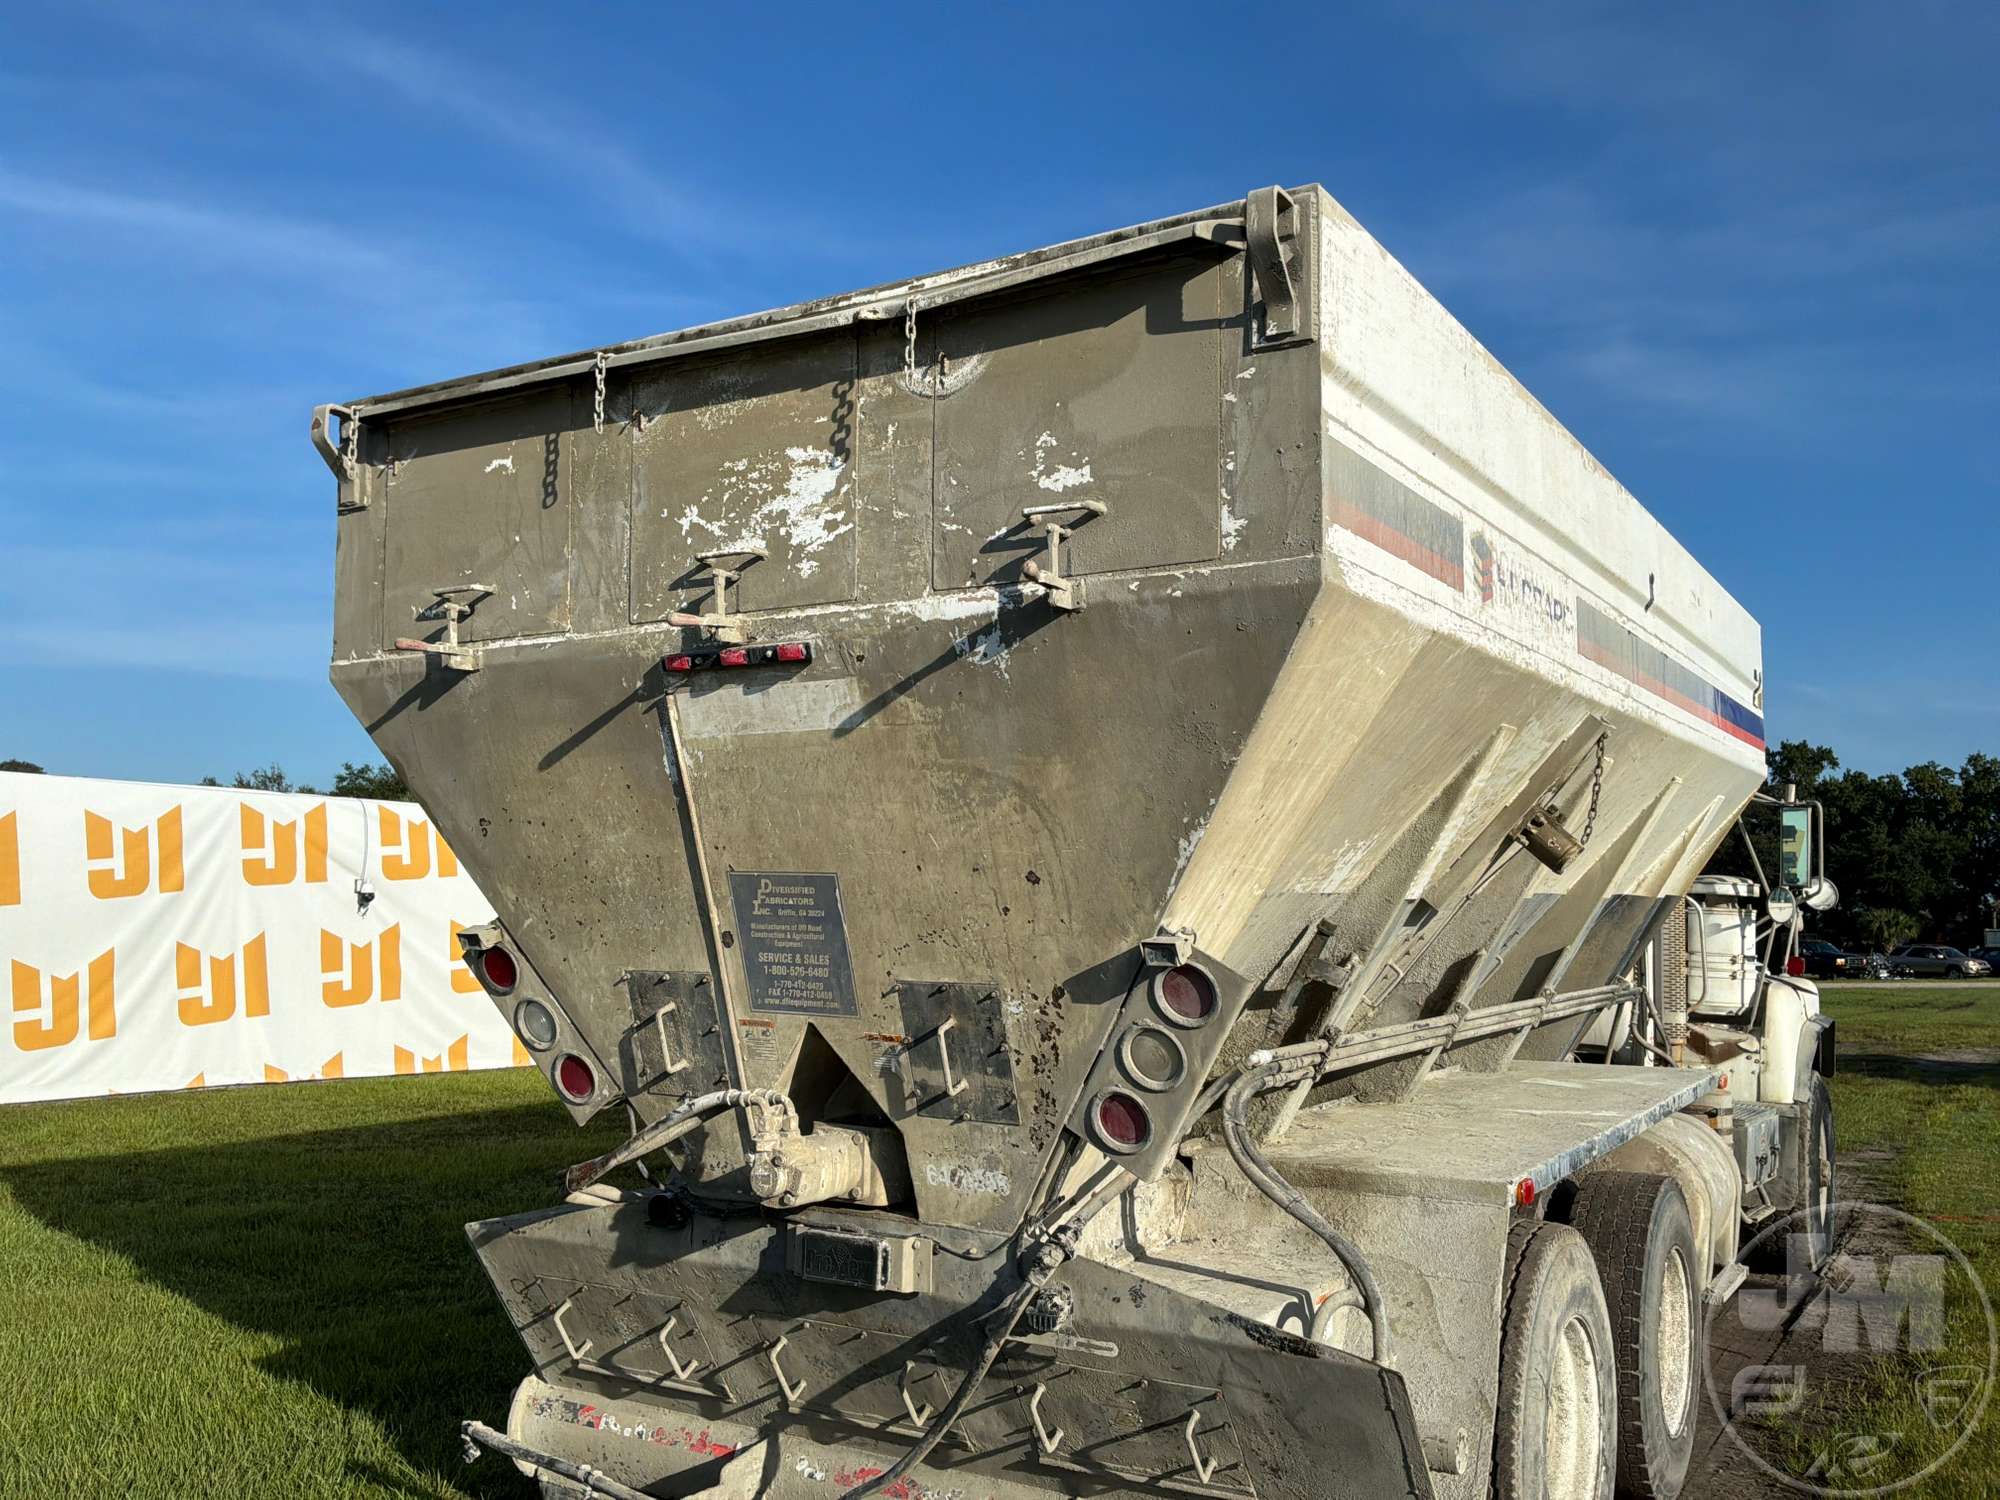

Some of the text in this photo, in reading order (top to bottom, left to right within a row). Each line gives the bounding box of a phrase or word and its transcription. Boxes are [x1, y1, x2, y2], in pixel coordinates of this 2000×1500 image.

[758, 952, 830, 966] SERVICE & SALES
[768, 987, 781, 996] FAX
